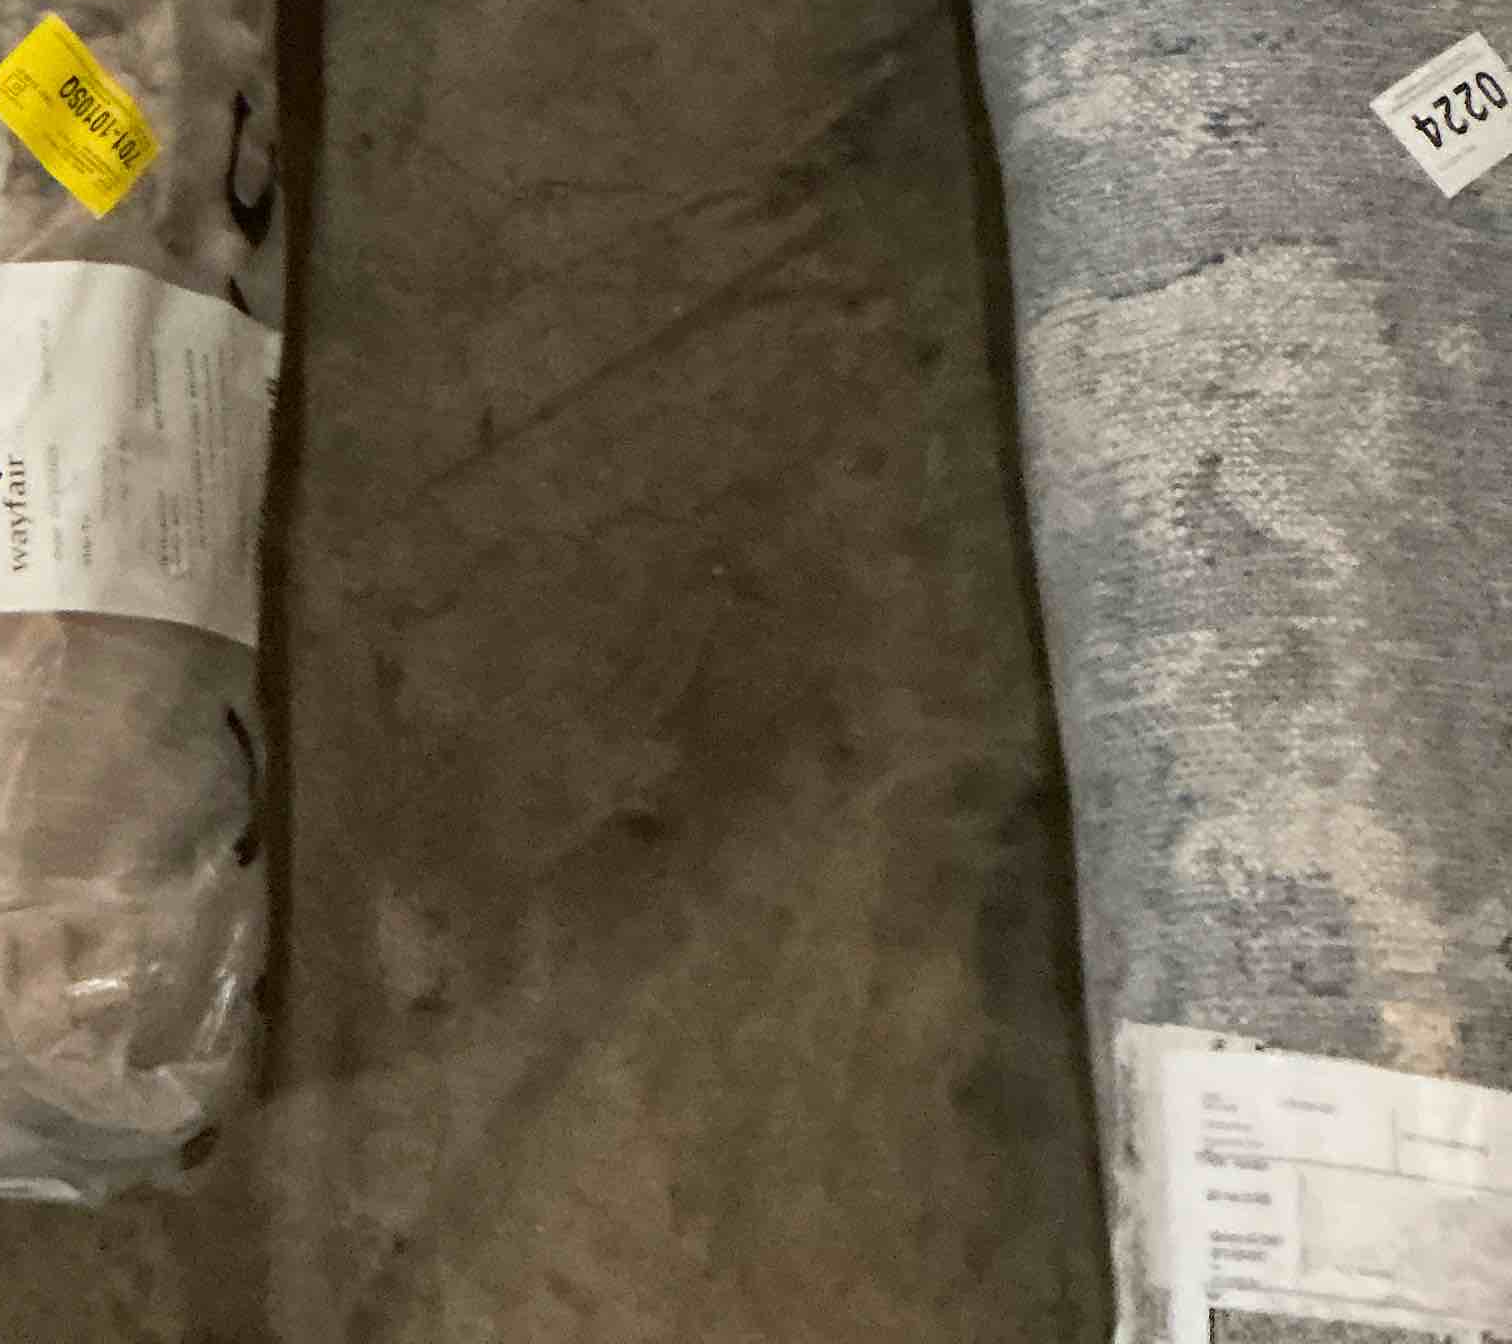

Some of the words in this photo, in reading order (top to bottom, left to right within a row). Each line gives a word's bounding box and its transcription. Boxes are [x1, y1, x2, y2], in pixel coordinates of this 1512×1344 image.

[60, 75, 142, 170] 701-1010SQ
[1412, 72, 1508, 148] 0224
[6, 453, 29, 573] wayfair
